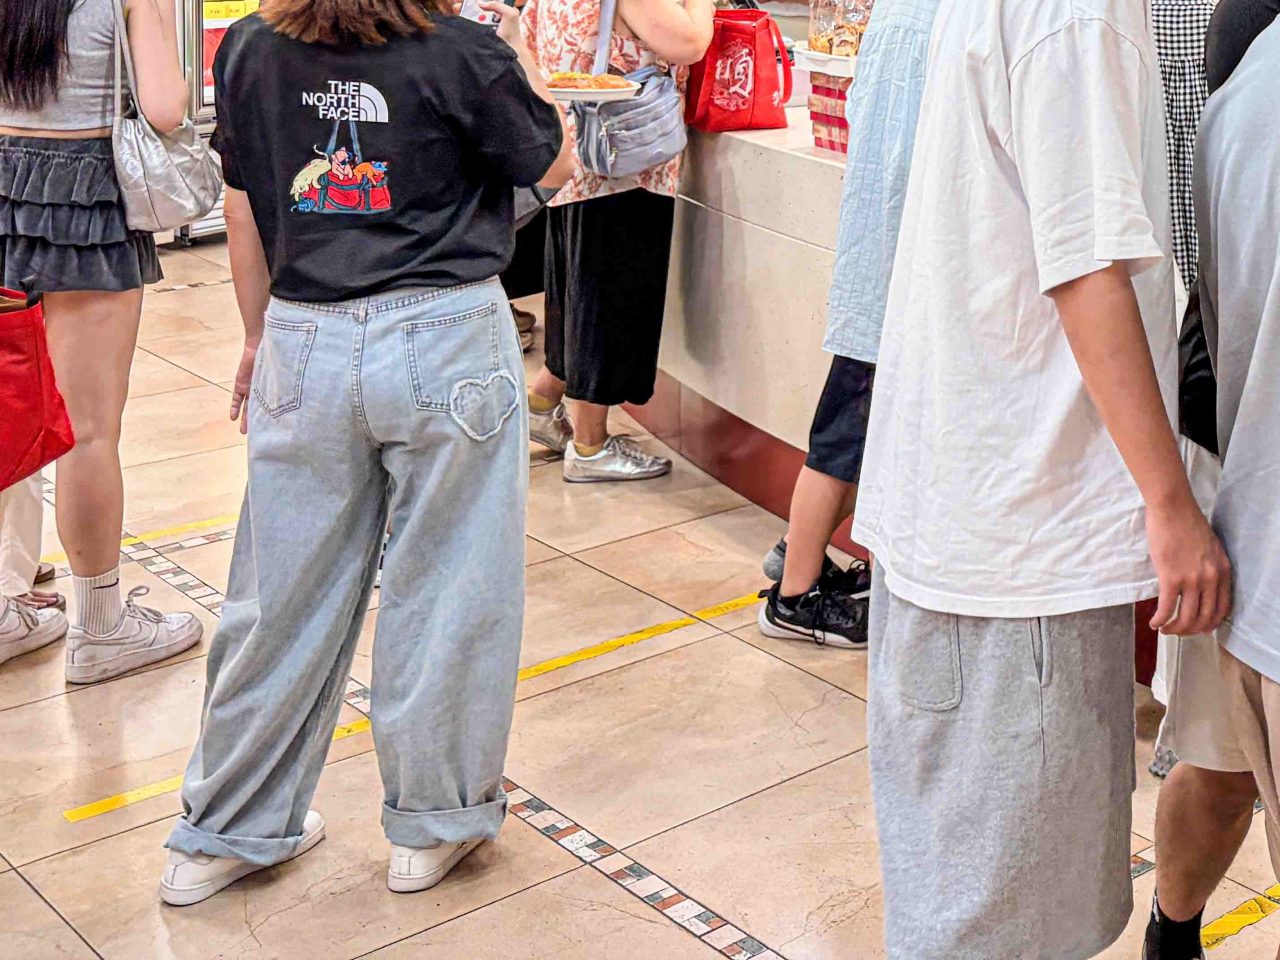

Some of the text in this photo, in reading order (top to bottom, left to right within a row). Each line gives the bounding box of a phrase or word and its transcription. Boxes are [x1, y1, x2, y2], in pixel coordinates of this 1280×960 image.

[328, 80, 360, 95] THE
[302, 91, 359, 108] NORTH
[318, 106, 360, 121] FACE
